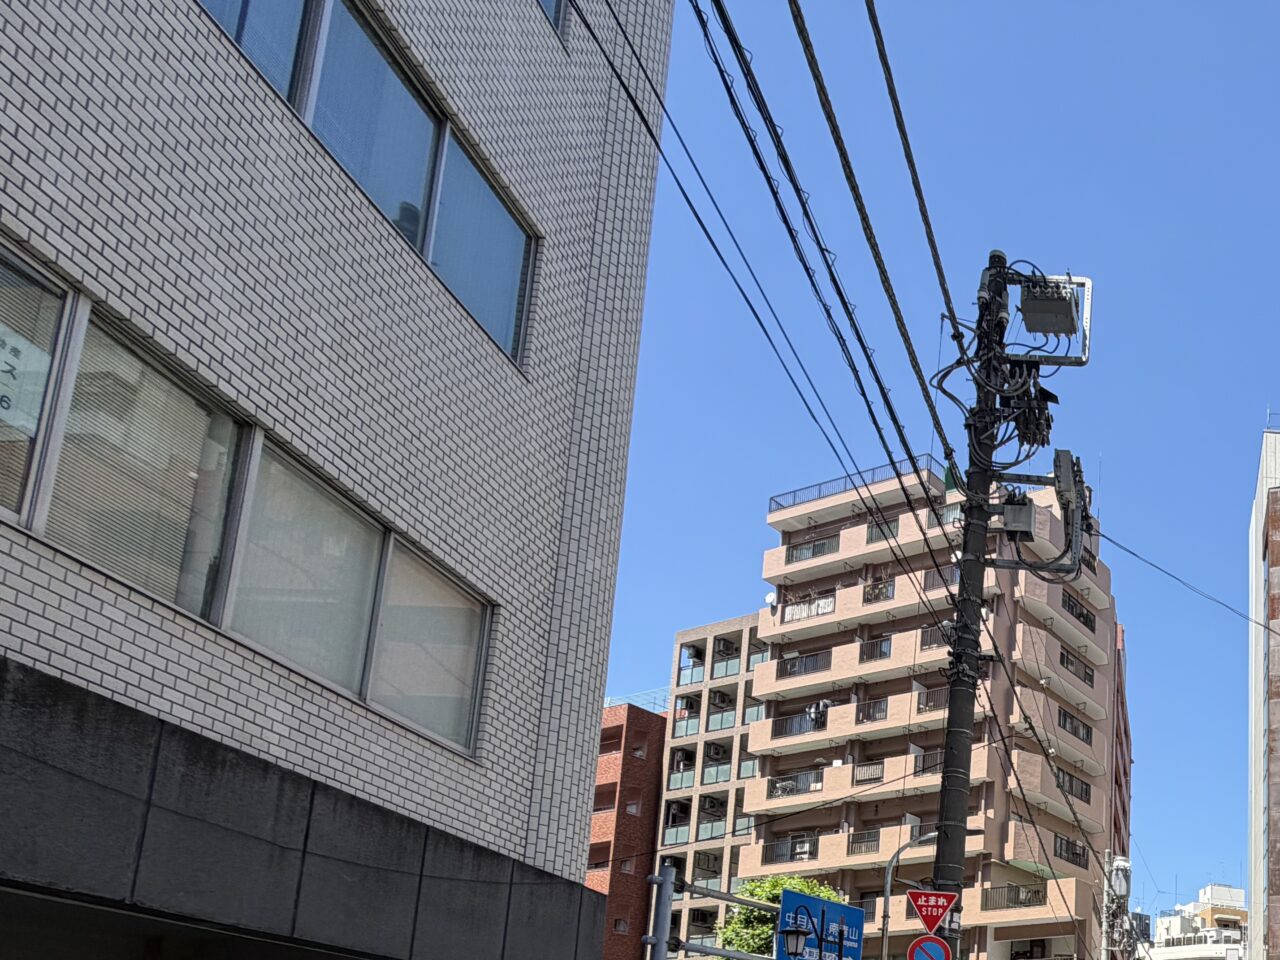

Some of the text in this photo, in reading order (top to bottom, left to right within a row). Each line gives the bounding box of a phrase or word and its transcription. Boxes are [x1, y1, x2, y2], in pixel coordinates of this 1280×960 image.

[917, 895, 948, 907] 止まれ
[921, 907, 944, 917] STOP
